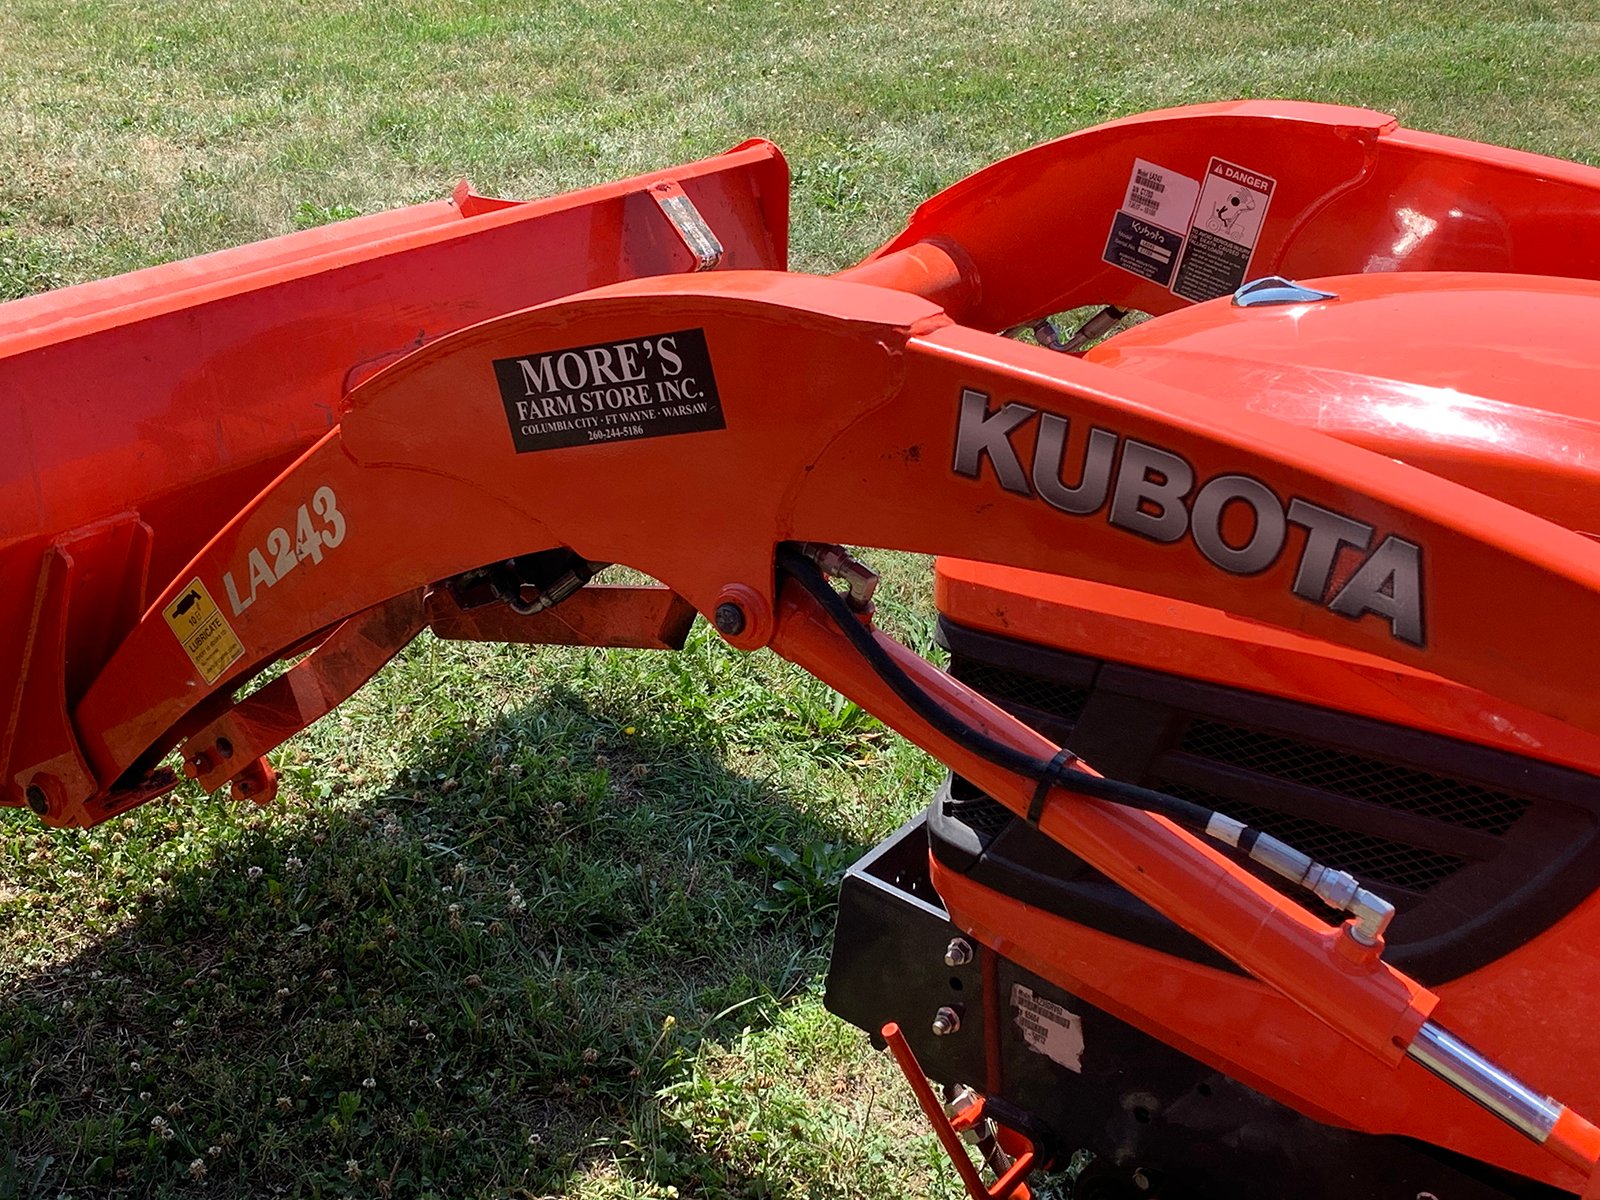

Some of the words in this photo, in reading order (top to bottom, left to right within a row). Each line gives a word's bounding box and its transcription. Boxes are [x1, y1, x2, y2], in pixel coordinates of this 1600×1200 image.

[1225, 167, 1269, 190] DANGER
[1132, 221, 1165, 243] Kubota
[1189, 239, 1207, 249] FALLING
[1199, 232, 1212, 240] AVOID
[1213, 237, 1233, 248] SERIOUS
[1200, 238, 1216, 247] DEATH
[1219, 245, 1239, 256] CAUSED
[516, 336, 683, 396] MORE'S
[516, 394, 577, 421] FARM
[579, 384, 652, 412] STORE
[657, 377, 704, 402] INC.
[521, 418, 575, 436] COLUMBIA
[574, 416, 600, 428] CITY
[605, 414, 619, 425] FT
[618, 409, 656, 423] WAYNE
[662, 402, 709, 418] WARSAW
[587, 425, 644, 441] 260-244-5186
[951, 387, 1427, 648] KUBOTA
[222, 485, 347, 618] LA243
[188, 617, 222, 653] LUBRICATE
